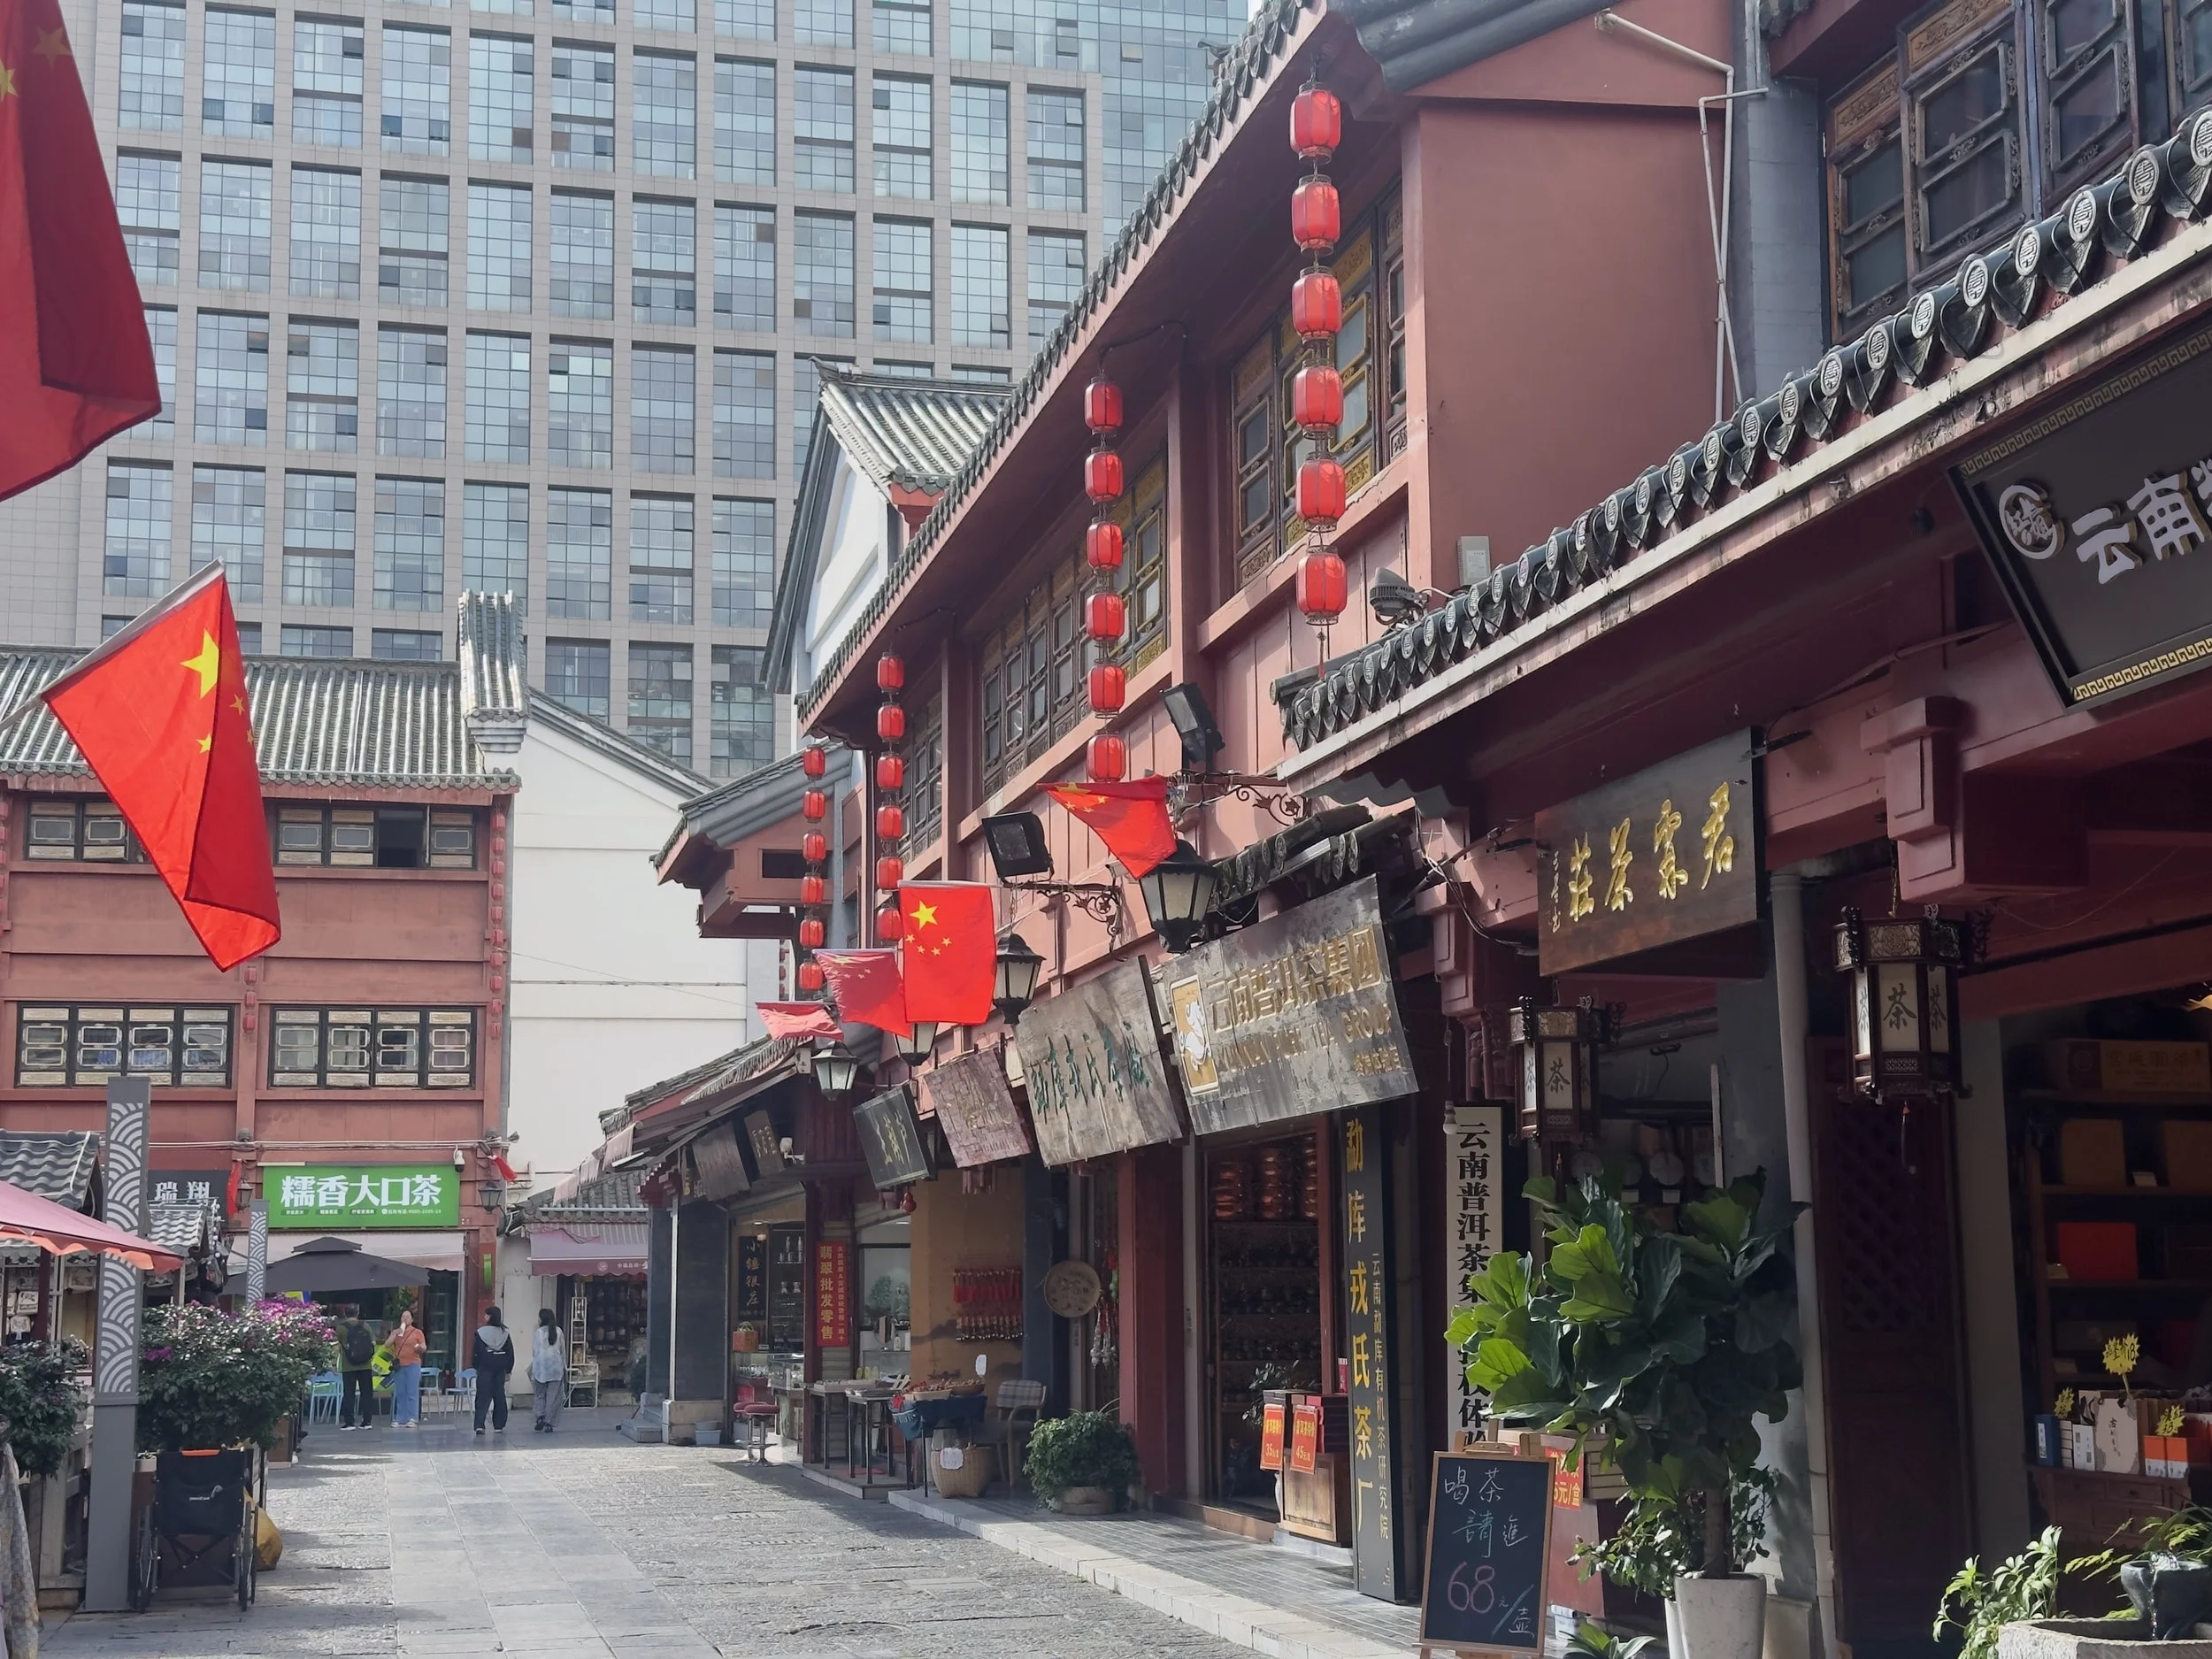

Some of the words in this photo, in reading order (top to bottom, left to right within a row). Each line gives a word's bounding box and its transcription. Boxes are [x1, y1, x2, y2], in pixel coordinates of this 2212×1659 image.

[1204, 926, 1383, 1033] 云南普洱茶集团
[1340, 1002, 1393, 1044] GROUP
[1883, 982, 1917, 1032] 茶
[1546, 1056, 1571, 1094] 茶
[280, 1174, 442, 1208] 糯香大口茶
[819, 1244, 834, 1340] 翡翠批发零售
[1346, 1118, 1374, 1532] 勐库戎氏茶厂
[1371, 1252, 1389, 1540] 云南勐库有机茶研究院
[1444, 1465, 1505, 1506] 喝茶
